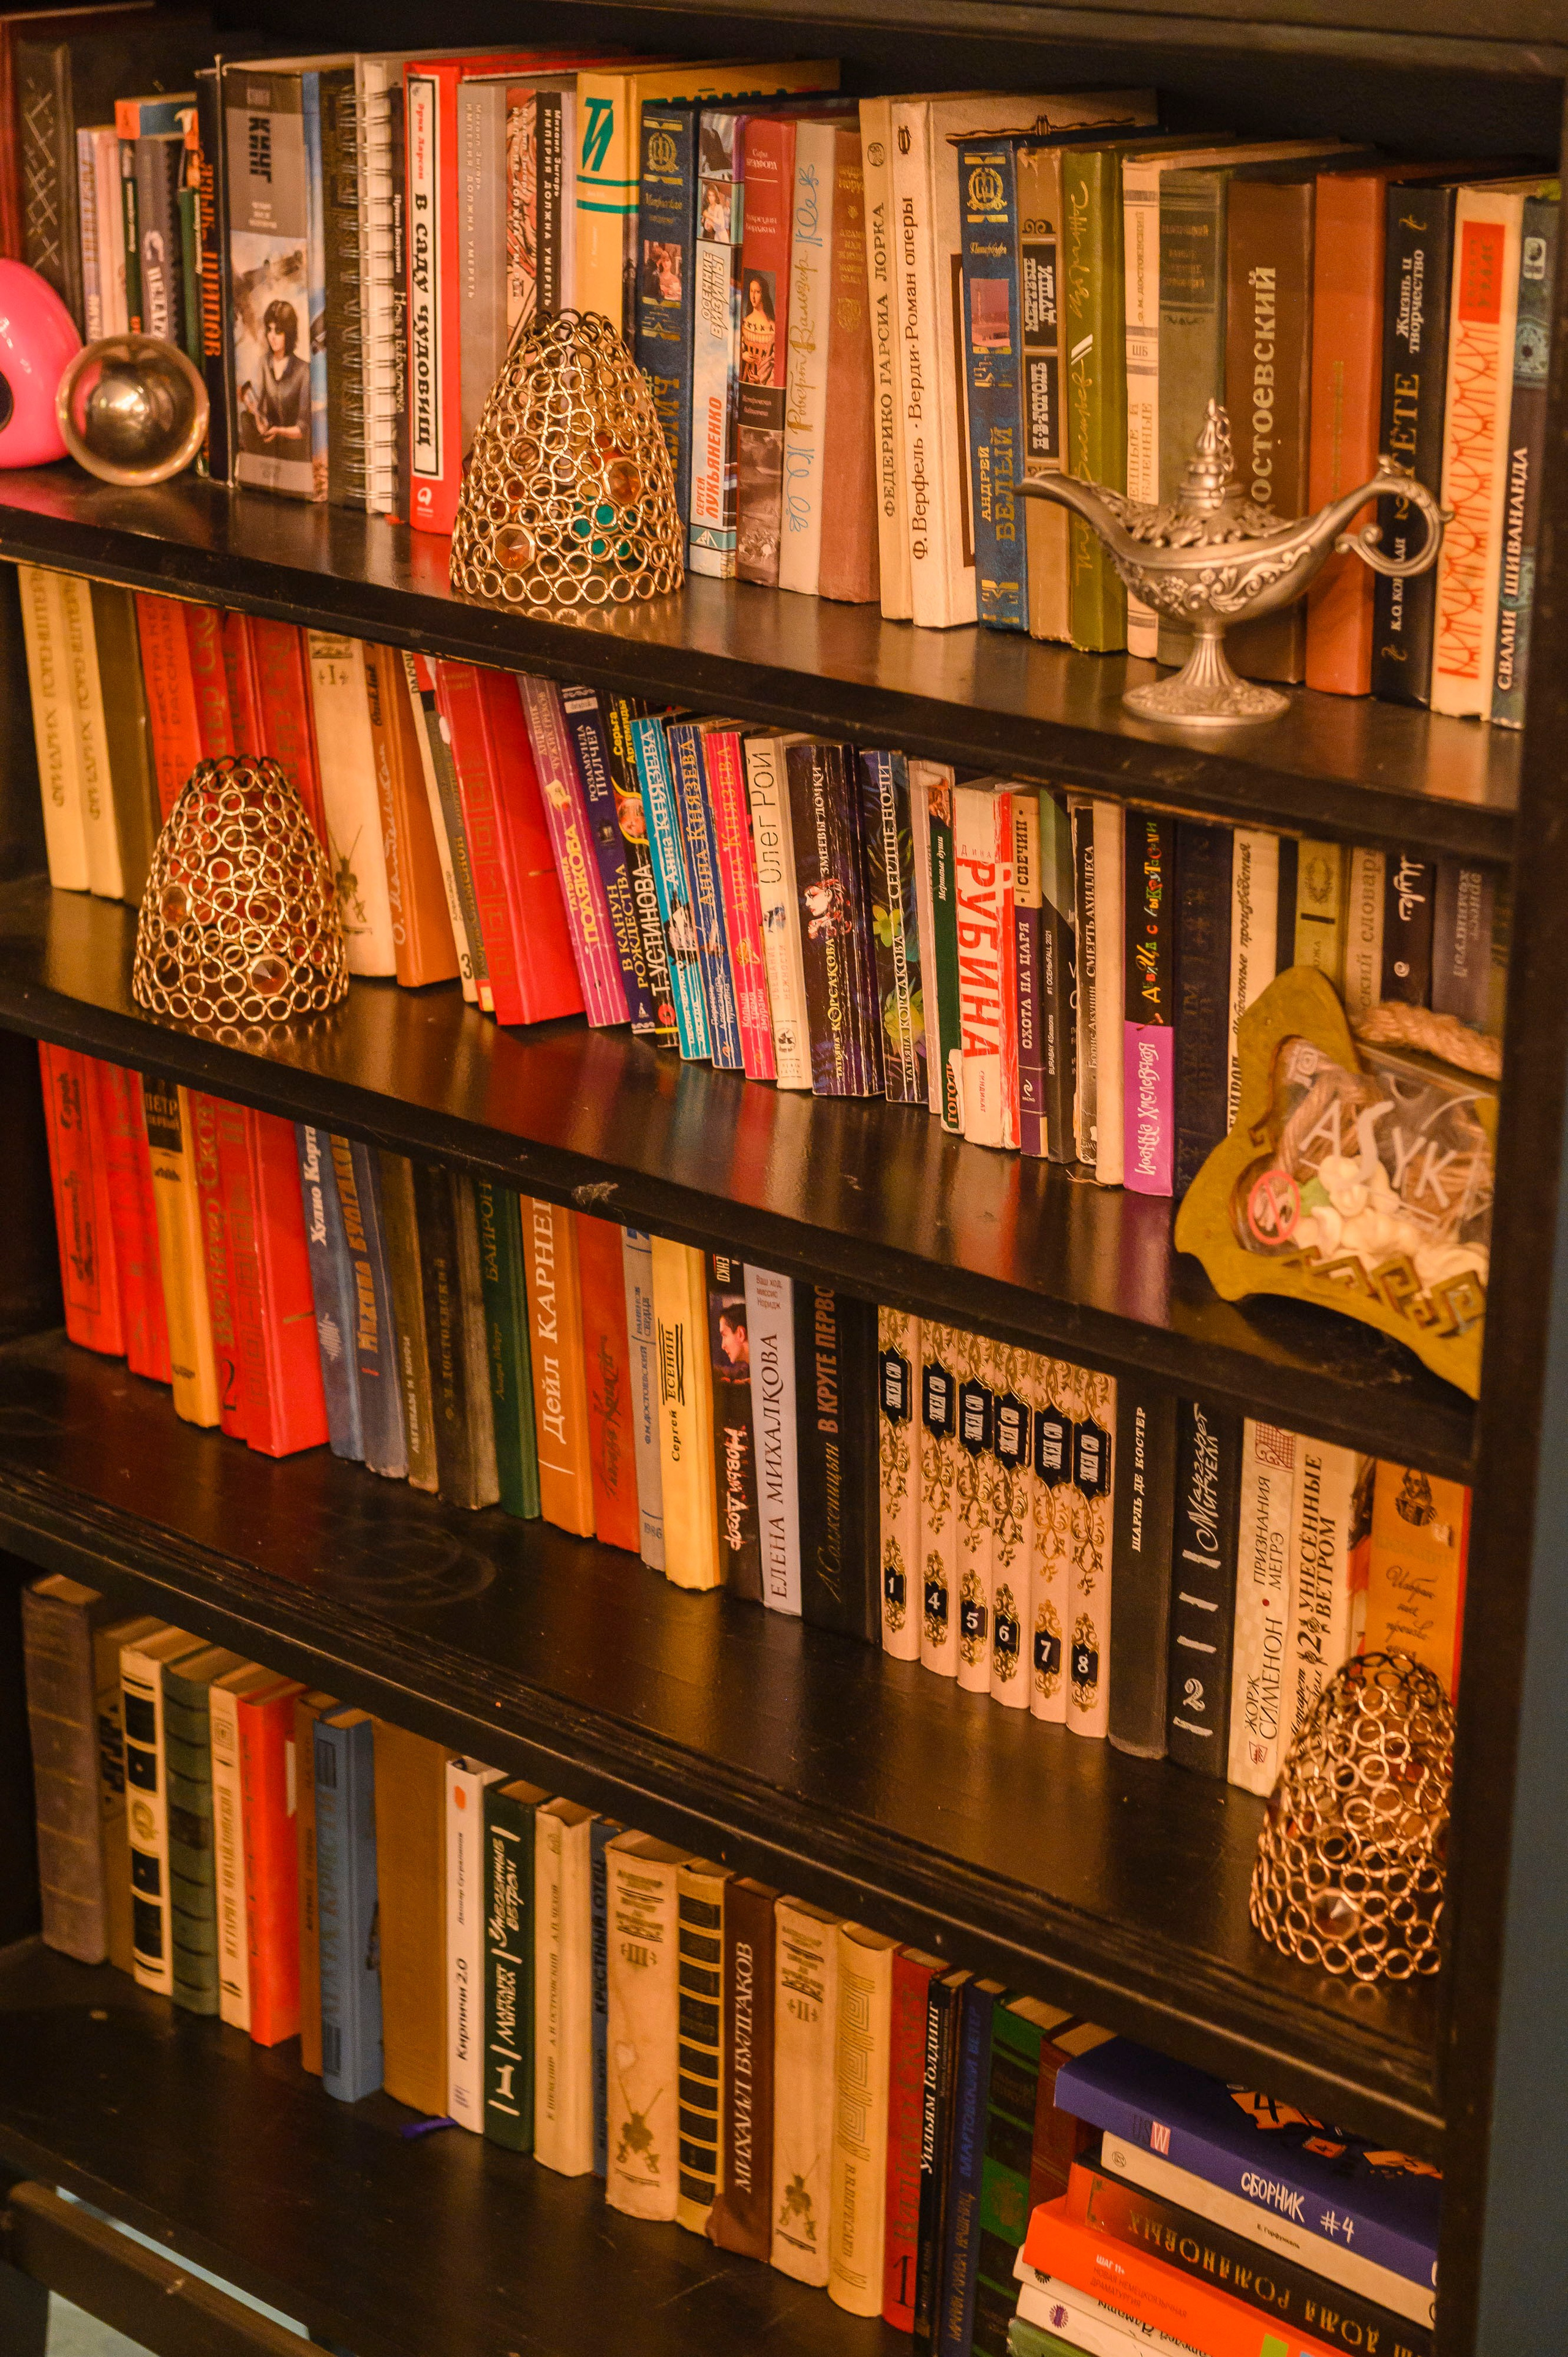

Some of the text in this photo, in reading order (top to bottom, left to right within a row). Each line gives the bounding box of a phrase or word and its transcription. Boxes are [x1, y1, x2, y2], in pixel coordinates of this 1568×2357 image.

[249, 117, 271, 183] КИНГ
[553, 110, 562, 153] Михаил
[901, 197, 919, 265] оперы
[203, 251, 221, 356] ШИПОВ
[701, 252, 714, 320] ОСЕННИЕ
[709, 254, 729, 339] ВИЗИТЫ
[1023, 258, 1039, 331] МЕРТВЫЕ
[1038, 265, 1057, 323] ДУШИ
[1396, 258, 1412, 338] Жизнь и
[1409, 249, 1425, 353] творчество
[413, 223, 431, 446] саду чудовищ
[872, 203, 895, 518] ФЕДЕРИКО ГАРСИА ЛОРКА
[1248, 266, 1276, 502] остоевский
[695, 477, 704, 516] СЕРГЕЙ
[704, 396, 722, 519] ЛУКЬЯНЕНКО
[911, 438, 930, 532] Верфель
[978, 446, 992, 522] АНДРЕЙ
[990, 426, 1015, 541] БЕЛЫЙ
[1497, 447, 1528, 690] СВАМИ ШИВАНАНДА
[576, 724, 598, 802] РОЗАМУНДА
[586, 725, 608, 796] ПИЛЧЕР
[608, 711, 625, 756] Серьга
[617, 699, 635, 764] Артемиды
[640, 728, 679, 886] Анна КНЯЗЕВА
[680, 738, 714, 905] АННА КНЯЗЕВА
[717, 745, 750, 913] АННА КНЯЗЕВА
[748, 752, 782, 884] Олег Рой
[811, 766, 831, 875] ЗМЕЕВЫ ДОЧКИ
[878, 765, 900, 899] СЕРДЦЕ НОЧИ
[561, 857, 578, 913] ТАТЬЯНА
[564, 823, 600, 944] ПОЛЯКОВА
[937, 836, 946, 901] Мертвые души
[1016, 820, 1030, 886] СВЕЧИН
[1084, 846, 1095, 918] АХИЛЛЕСА
[606, 884, 634, 973] В КАНУН
[615, 863, 649, 989] РОЖДЕСТВА
[633, 863, 668, 976] УСТИНОВА
[955, 859, 1000, 1057] РУБИНА
[1085, 919, 1096, 978] СМЕРТЬ
[739, 992, 749, 1027] Кольцо
[748, 991, 759, 1019] тремя
[756, 989, 769, 1031] амурами
[824, 936, 843, 1077] ТАТЬЯНА КОРСАКОВА
[894, 935, 914, 1082] ТАТЬЯНА КОРСАКОВА
[1018, 921, 1034, 1049] ОХОТА НА ЦАРЯ
[310, 1186, 328, 1246] Хулио
[542, 1356, 568, 1444] Дейл
[663, 1329, 682, 1461] Сергей ЕСЕНИН
[816, 1352, 839, 1412] КРУГЕ
[760, 1333, 788, 1599] ЕЛЕНА МИХАЛКОВА
[1132, 1406, 1146, 1552] ШАРЛЬ ДЕ КОСТЕР
[1253, 1475, 1270, 1586] ПРИЗНАНИЯ
[1268, 1532, 1284, 1591] МЕГРЭ
[1298, 1454, 1322, 1613] УНЕСЁННЫЕ
[1315, 1515, 1336, 1620] ВЕТРОМ
[889, 1577, 894, 1593] 1
[927, 1592, 941, 1610] 4
[966, 1612, 979, 1629] 5
[999, 1625, 1009, 1642] 6
[1040, 1639, 1051, 1662] 7
[1077, 1654, 1089, 1674] 8
[1297, 1635, 1322, 1653] 2
[1244, 1674, 1261, 1735] ЖОРЖ
[1259, 1616, 1283, 1740] СИМЕНОН
[456, 1958, 470, 2061] Кирпичи 2.0
[734, 1942, 753, 2193] МИХАИЛ БУЛГАКОВ
[920, 2001, 940, 2174] Уильям Голдинг
[1241, 2172, 1355, 2243] СБОРНИК #4
[1096, 2255, 1115, 2269] ШАГ
[1128, 2209, 1291, 2310] РОМАНОВЫХ
